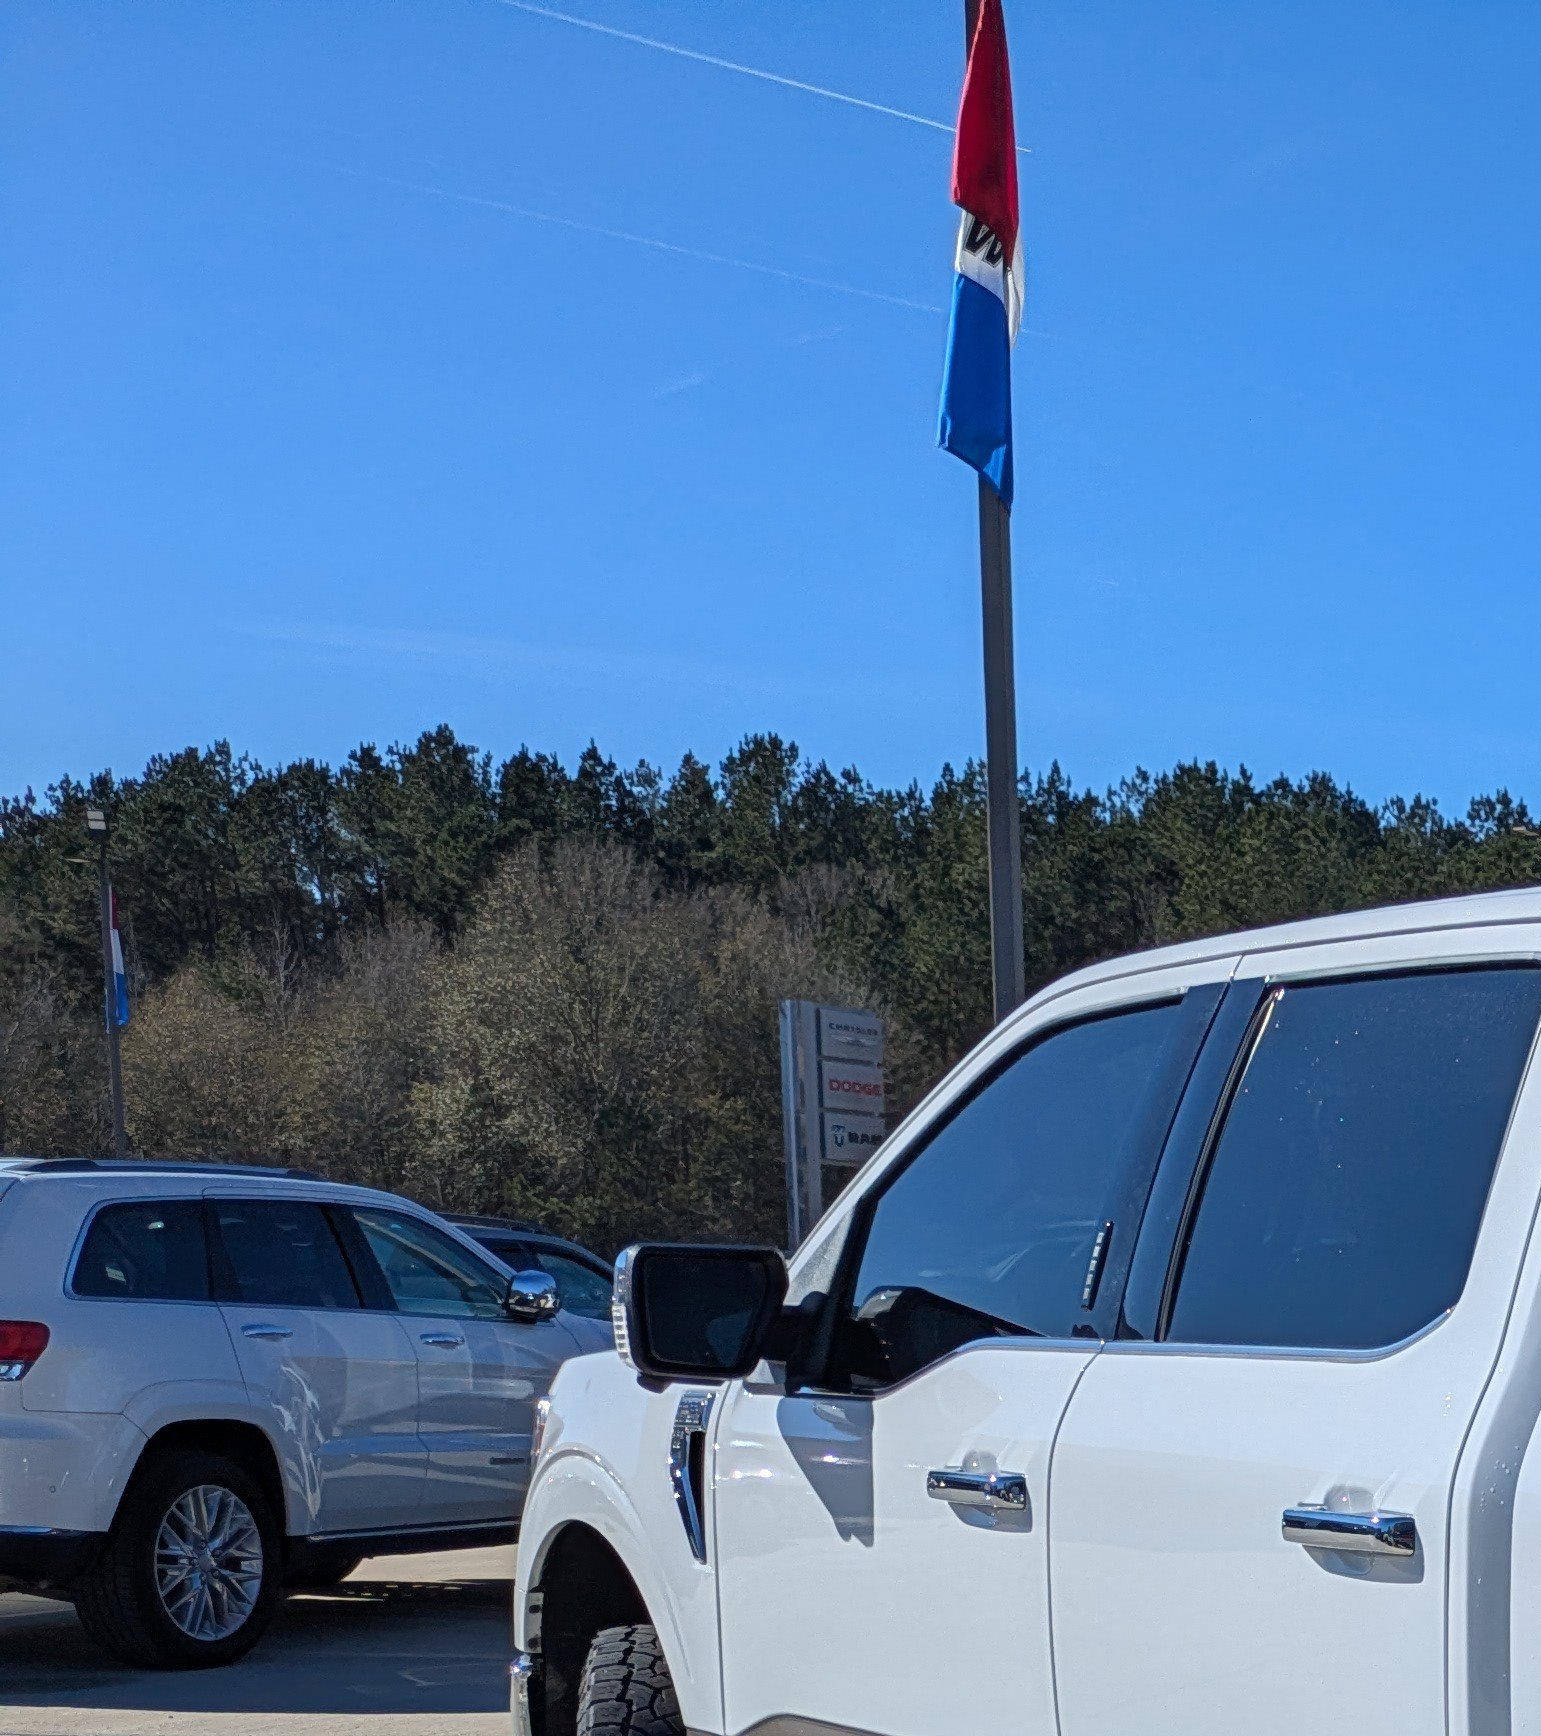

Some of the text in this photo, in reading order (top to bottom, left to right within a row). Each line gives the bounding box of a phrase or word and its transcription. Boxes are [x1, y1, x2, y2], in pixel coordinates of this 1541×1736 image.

[828, 1022, 878, 1036] CHRYSLER
[829, 1079, 882, 1096] DODGE
[847, 1131, 883, 1145] RAM
